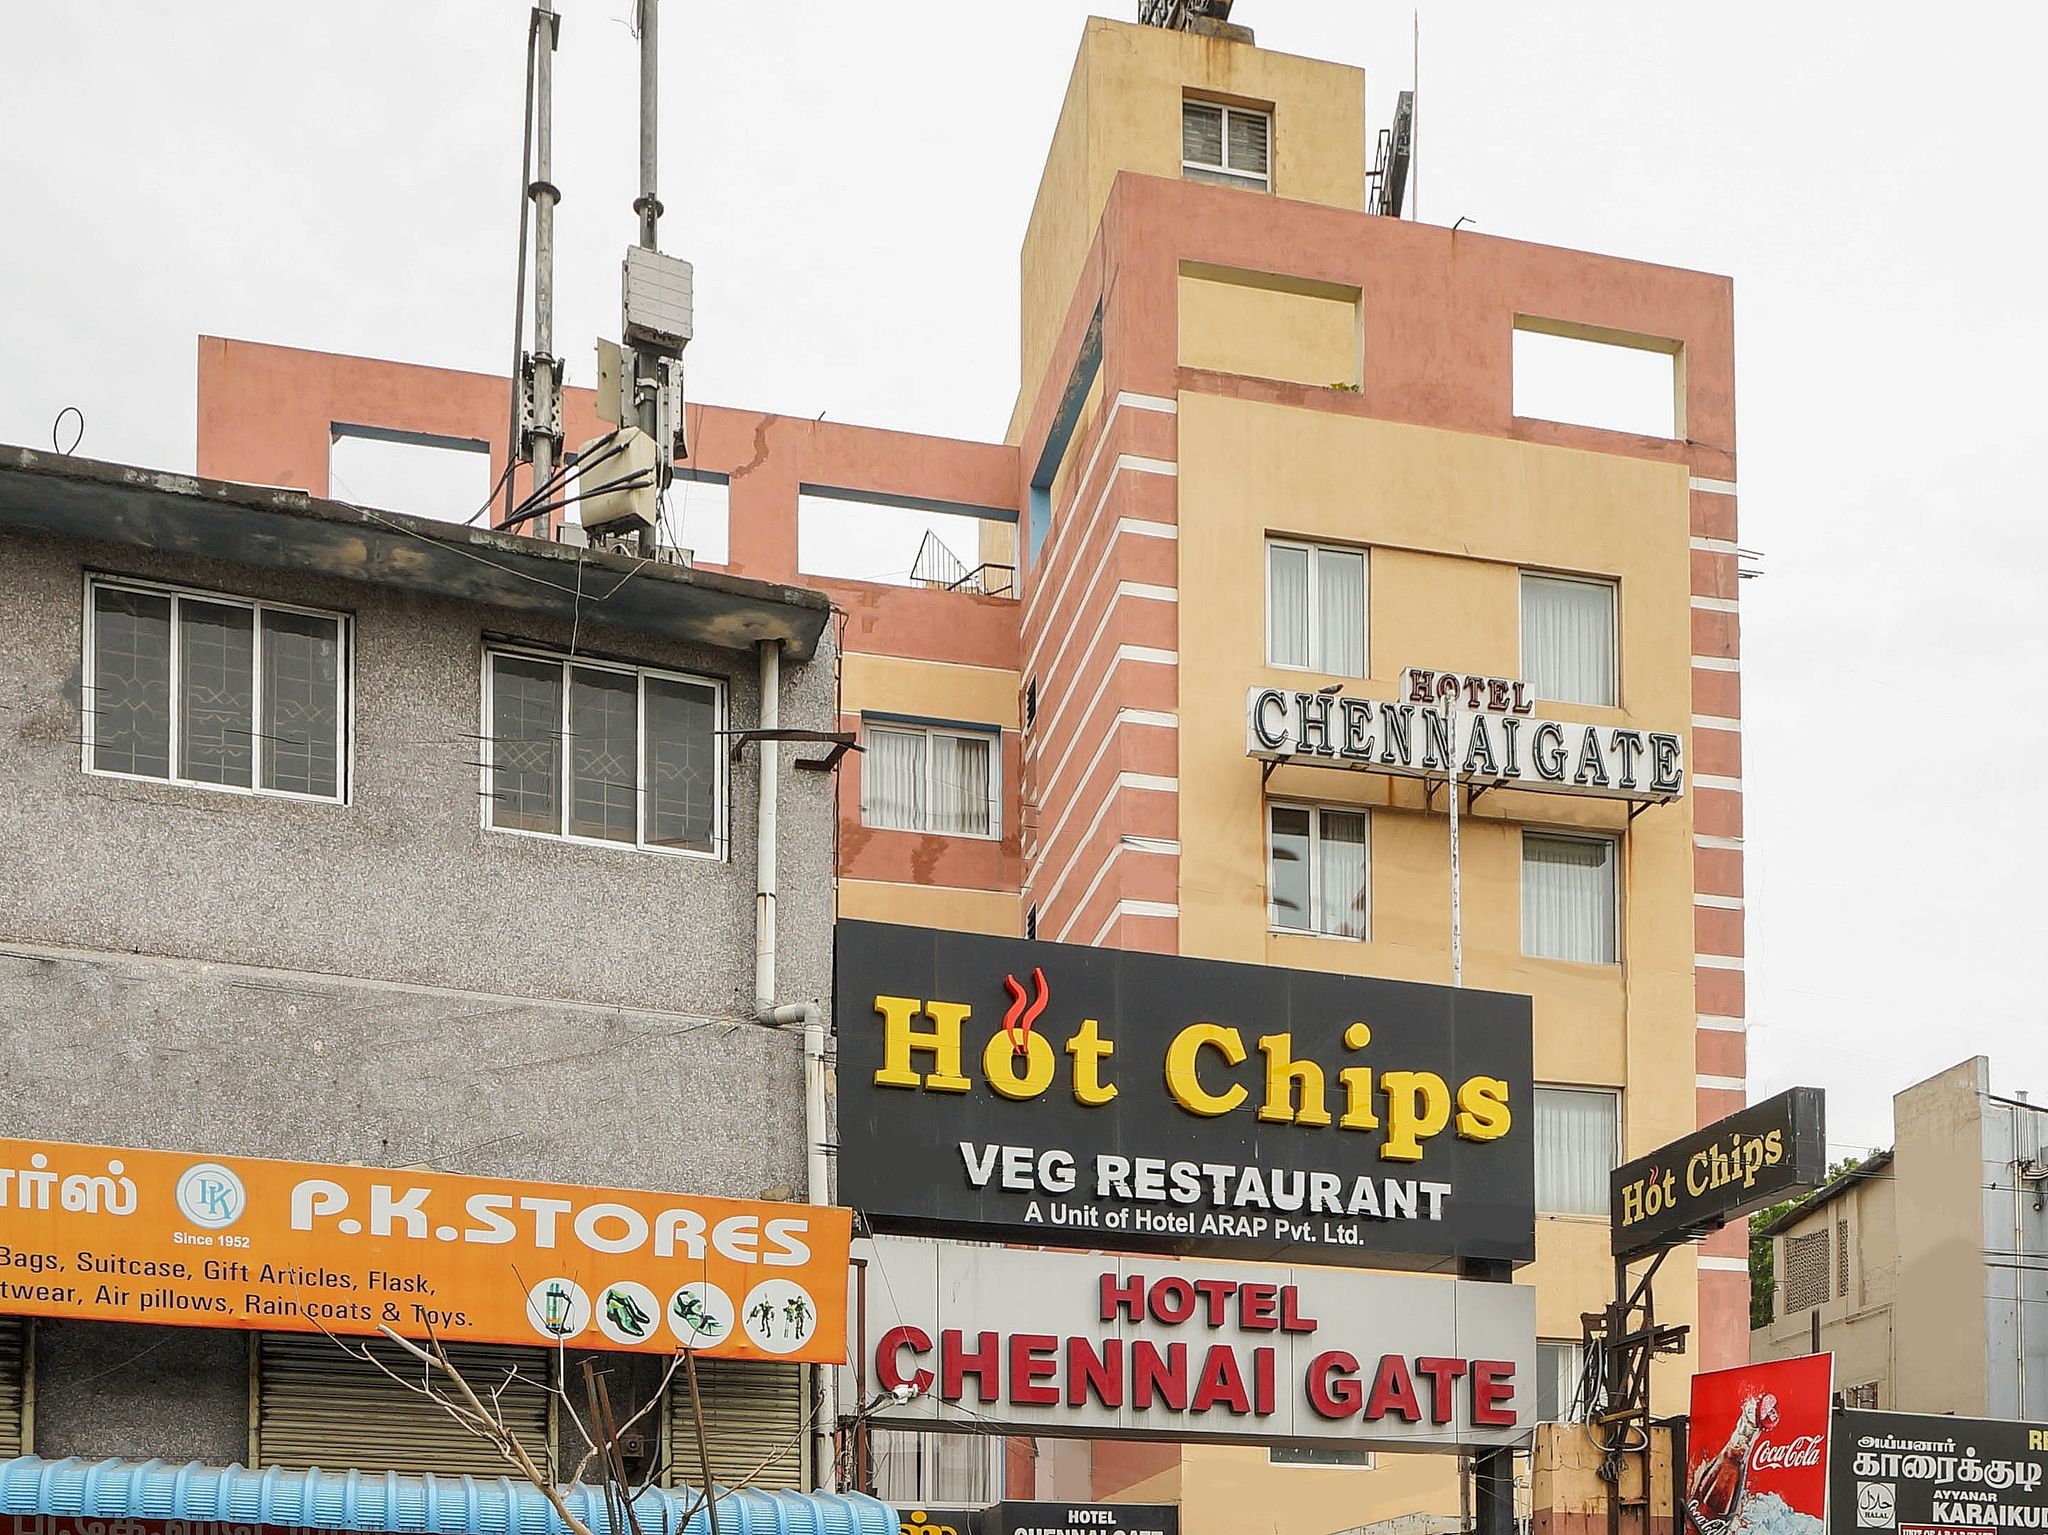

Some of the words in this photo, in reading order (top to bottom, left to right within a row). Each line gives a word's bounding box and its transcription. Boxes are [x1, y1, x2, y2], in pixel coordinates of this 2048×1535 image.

[1409, 669, 1533, 714] HOTEL
[875, 995, 1118, 1104] Hot
[1166, 1023, 1512, 1160] Chips
[959, 1141, 1076, 1193] VEG
[1096, 1154, 1452, 1222] RESTAURANT
[1621, 1168, 1677, 1227] Hot
[1686, 1128, 1784, 1198] Chips
[173, 1231, 213, 1246] Since
[217, 1235, 250, 1249] 1952
[1024, 1201, 1043, 1223] A
[1050, 1202, 1098, 1228] Unit
[1105, 1207, 1129, 1229] of
[1135, 1208, 1195, 1235] Hotel
[1200, 1214, 1268, 1238] ARAP
[1275, 1218, 1317, 1242] Pvt.
[1323, 1222, 1364, 1246] Ltd.
[0, 1246, 65, 1274] Bags,
[77, 1251, 193, 1281] Suitcase,
[204, 1260, 249, 1282] Gift
[259, 1263, 358, 1292] Articles,
[368, 1271, 436, 1296] Flask,
[95, 1285, 130, 1306] Air
[140, 1289, 235, 1315] pillows,
[245, 1295, 296, 1316] Rain
[307, 1303, 372, 1322] coats
[381, 1303, 401, 1322] &
[411, 1304, 474, 1328] Toys.
[1100, 1272, 1319, 1334] HOTEL
[875, 1325, 1277, 1416] CHENNAI
[1307, 1350, 1518, 1426] GATE
[1751, 1434, 1825, 1471] Coca-Cola
[1853, 1446, 2043, 1492] காரைக்குடி
[1068, 1510, 1117, 1525] HOTEL
[1864, 1511, 1889, 1520] HALAL
[1933, 1489, 1999, 1503] AYYANAR
